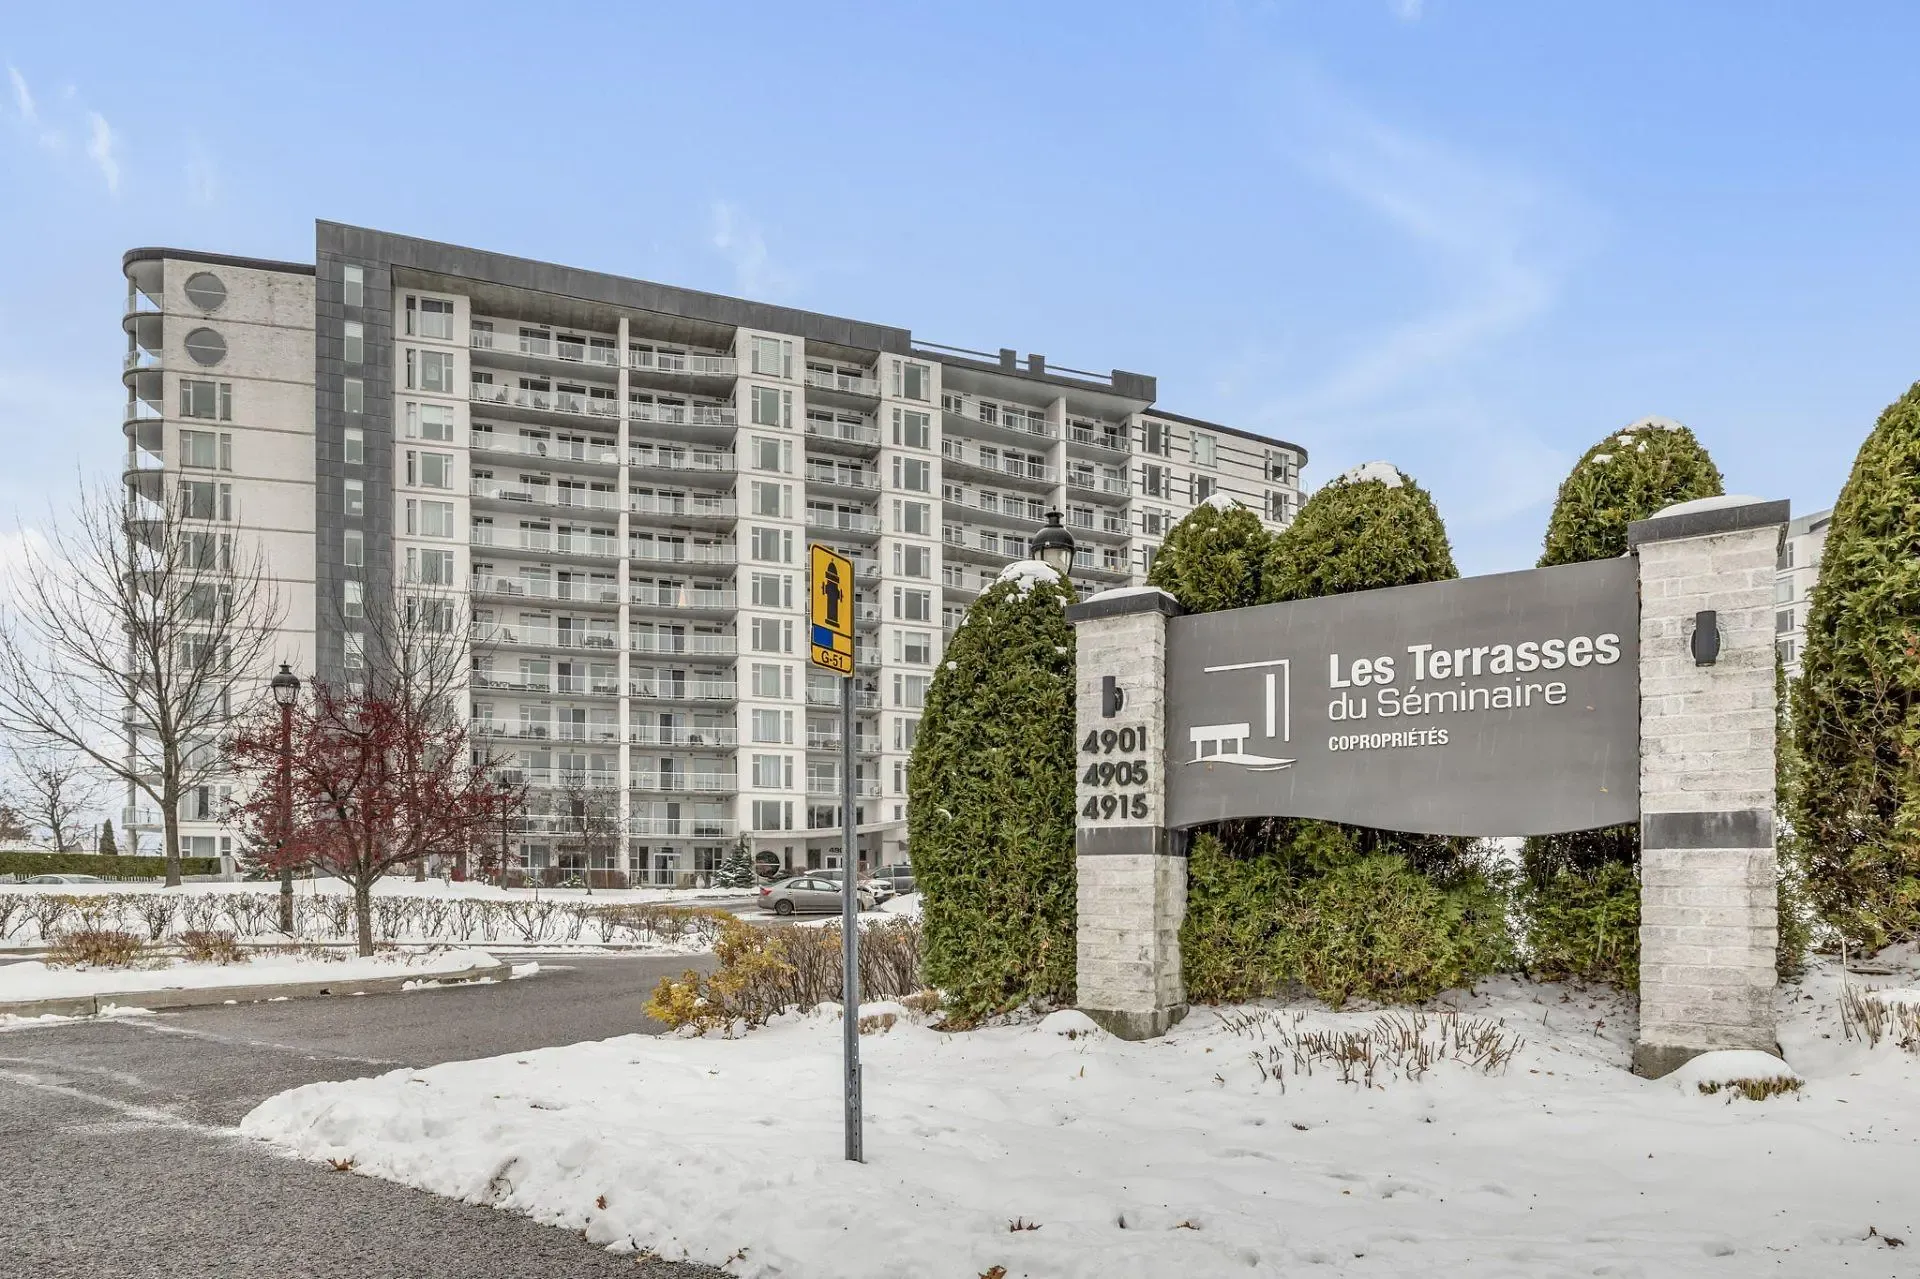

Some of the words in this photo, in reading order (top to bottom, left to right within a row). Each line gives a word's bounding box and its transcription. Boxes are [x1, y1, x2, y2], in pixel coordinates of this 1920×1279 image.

[822, 651, 843, 668] G-51
[1330, 653, 1395, 688] Les
[1407, 633, 1620, 680] Terrasses
[1328, 692, 1367, 721] du
[1377, 677, 1567, 717] Séminaire
[1082, 726, 1146, 754] 4901
[1328, 727, 1449, 751] COPROPRIÉTÉS
[1082, 760, 1148, 787] 4905
[1082, 793, 1148, 820] 4915
